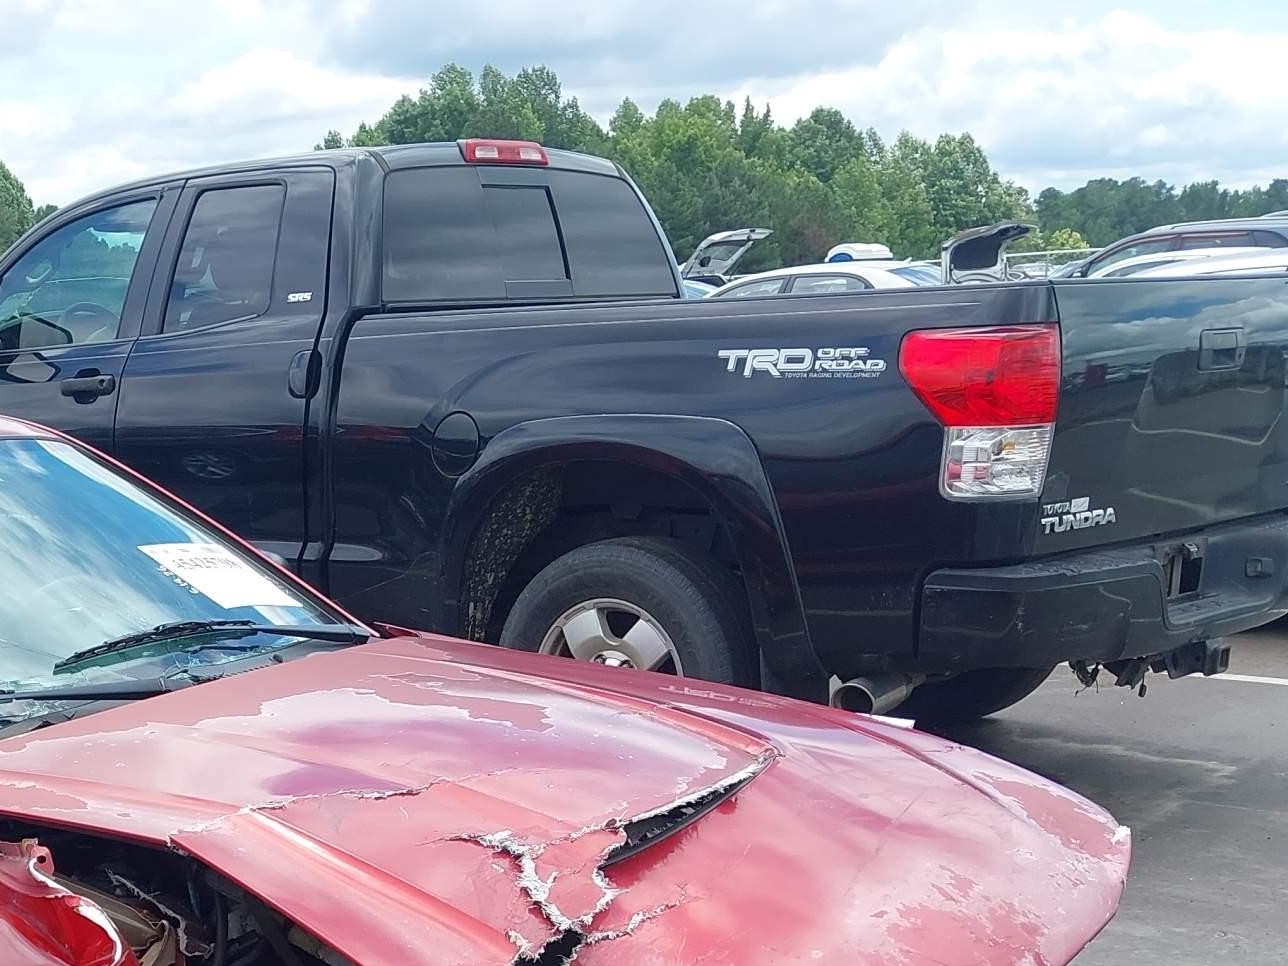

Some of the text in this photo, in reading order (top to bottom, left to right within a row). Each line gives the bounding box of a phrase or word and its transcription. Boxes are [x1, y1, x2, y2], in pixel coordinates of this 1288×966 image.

[718, 347, 871, 378] TRD OFF
[815, 359, 887, 372] ROAD
[1042, 501, 1071, 515] TOYOTA
[1040, 507, 1116, 535] TUNDRA
